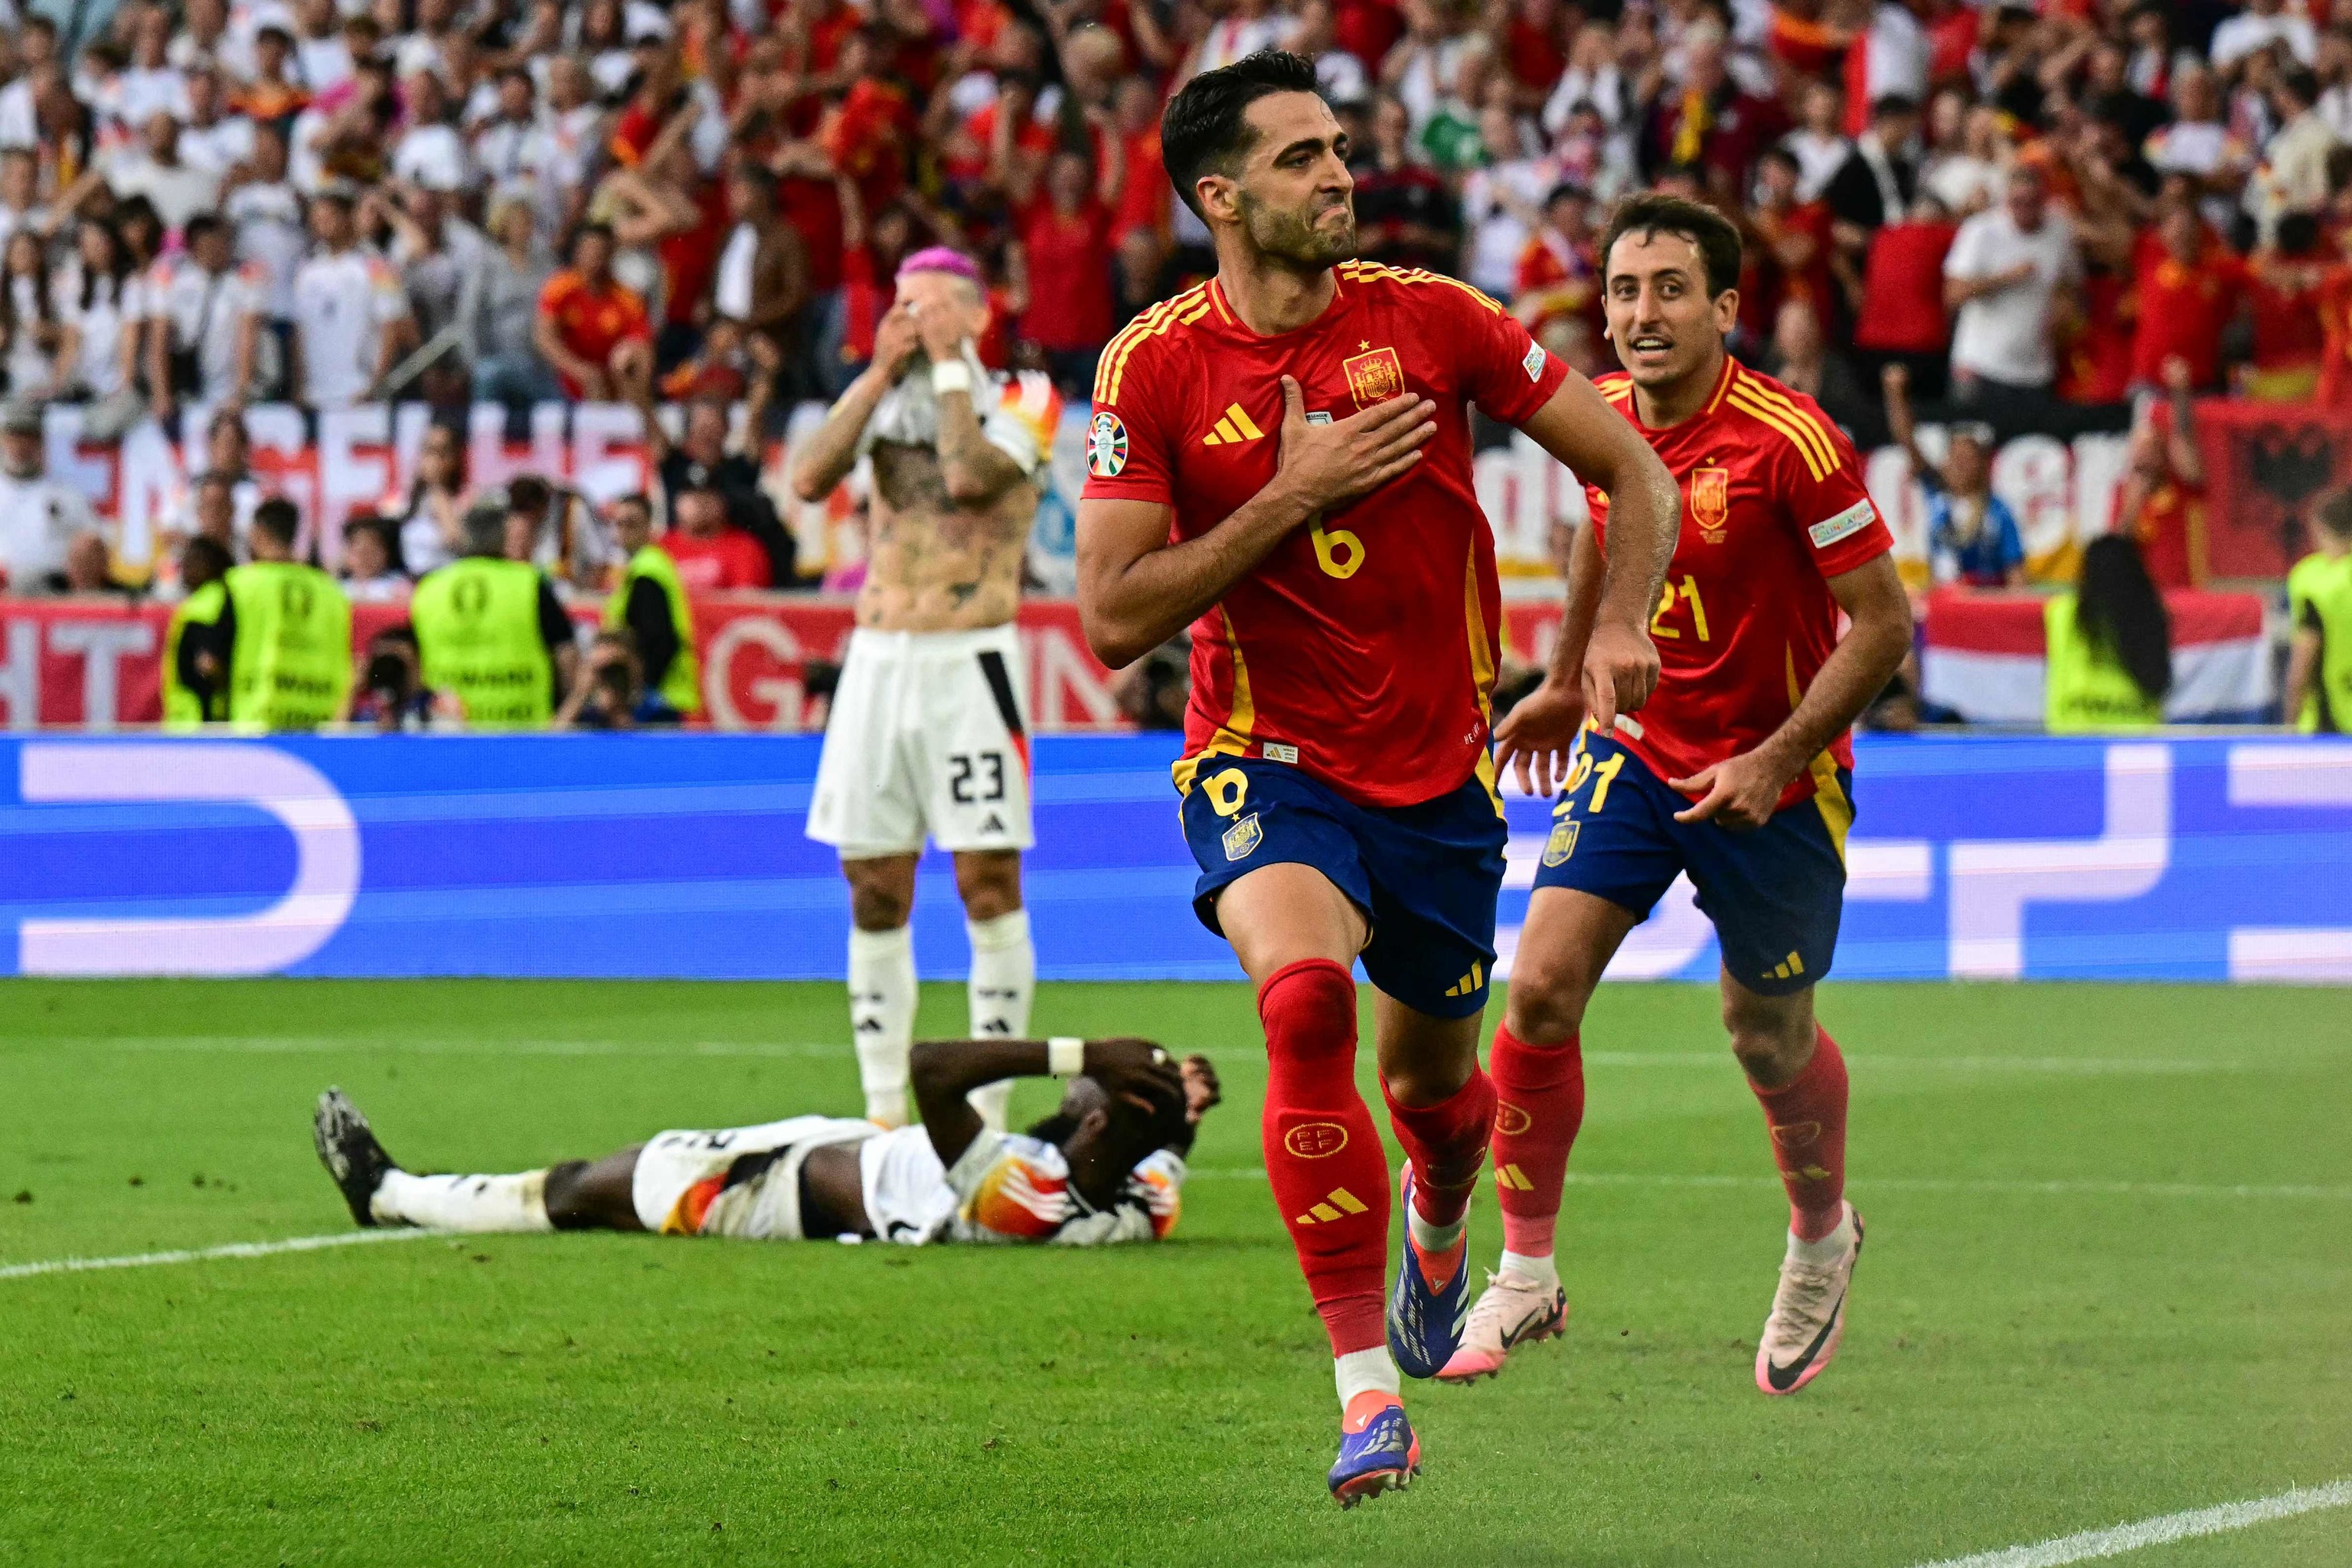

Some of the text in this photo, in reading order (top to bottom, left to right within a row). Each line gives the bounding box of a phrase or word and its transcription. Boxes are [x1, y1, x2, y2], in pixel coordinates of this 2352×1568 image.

[1308, 514, 1365, 579] 6
[1650, 574, 1710, 642] 21
[949, 753, 1004, 803] 23
[1201, 768, 1249, 817] 6
